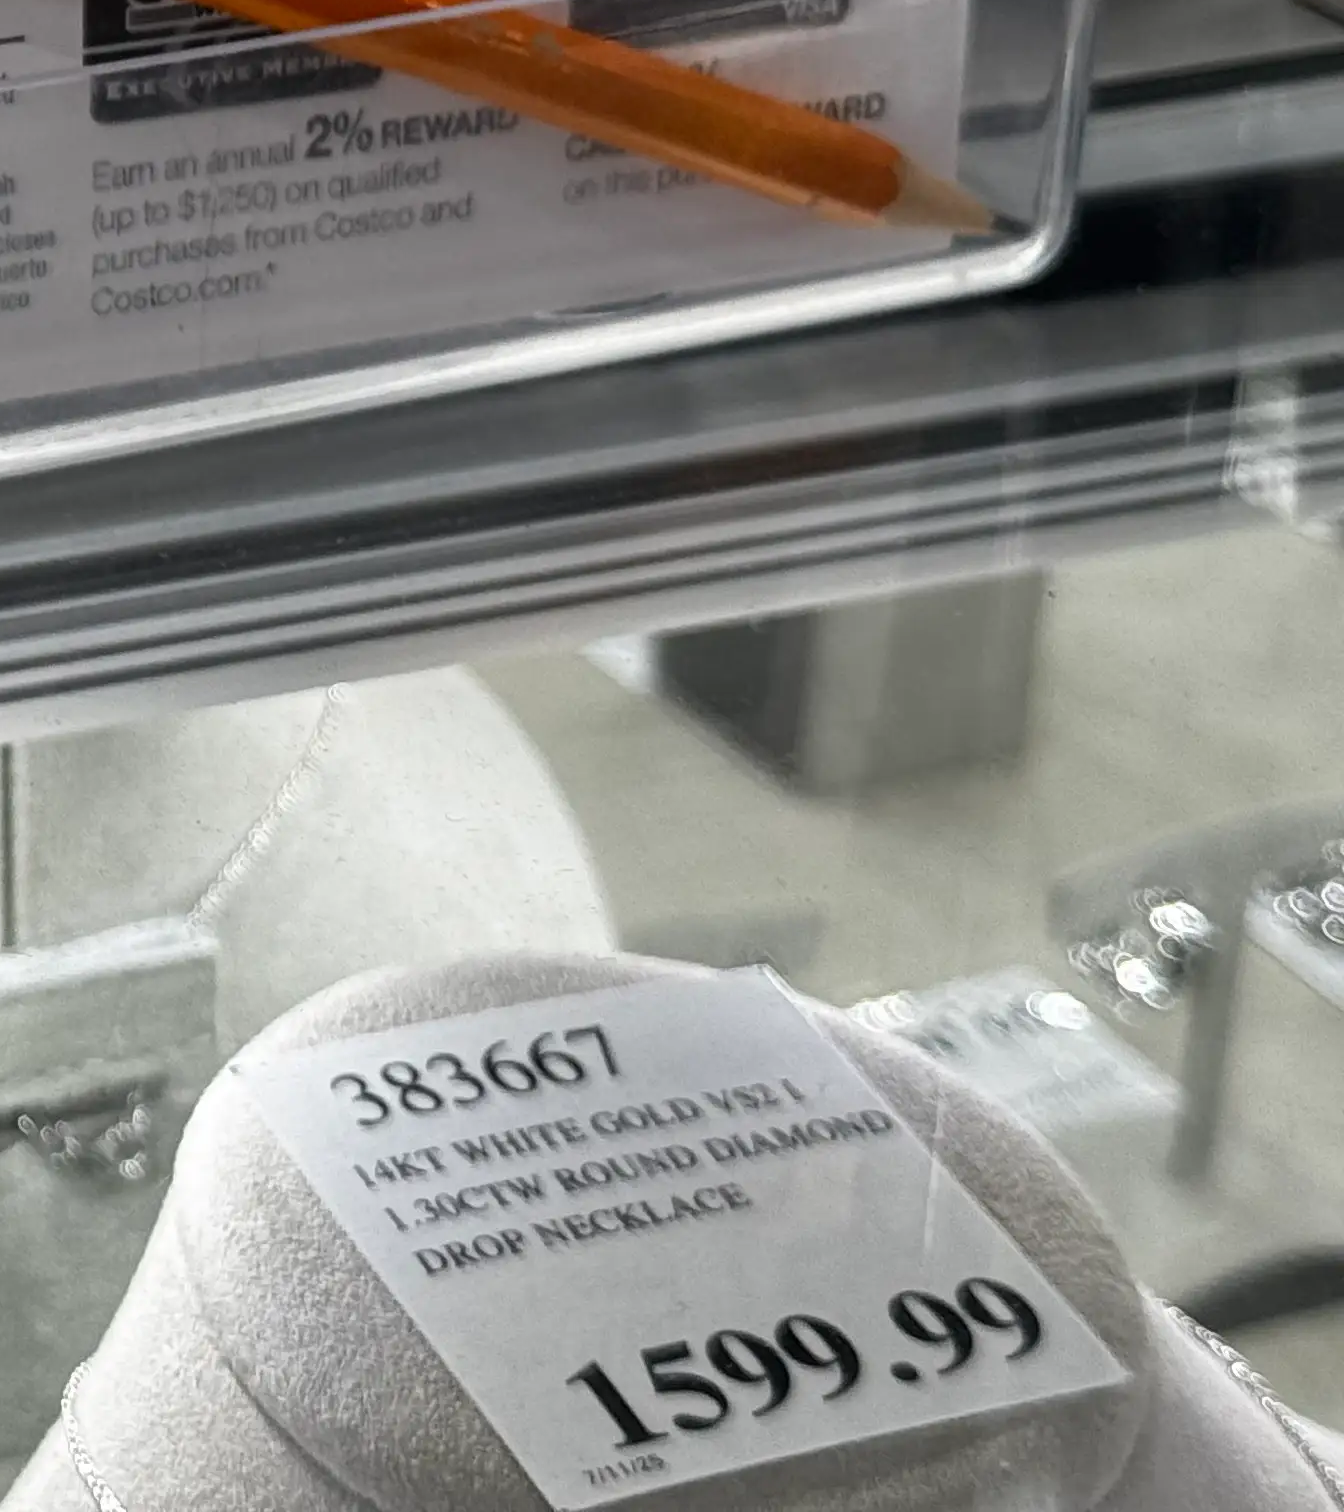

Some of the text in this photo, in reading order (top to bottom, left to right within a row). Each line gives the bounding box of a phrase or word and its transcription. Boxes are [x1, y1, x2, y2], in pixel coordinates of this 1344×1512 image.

[304, 107, 374, 159] 2%
[331, 1025, 622, 1129] 383667
[352, 1140, 446, 1191] 14KT
[452, 1115, 585, 1168] WHITE
[592, 1094, 702, 1138] GOLD
[704, 1084, 774, 1118] VS2
[384, 1109, 896, 1232] 1.30CTW ROUND DIAMOND
[415, 1182, 753, 1278] DROP NECKLACE
